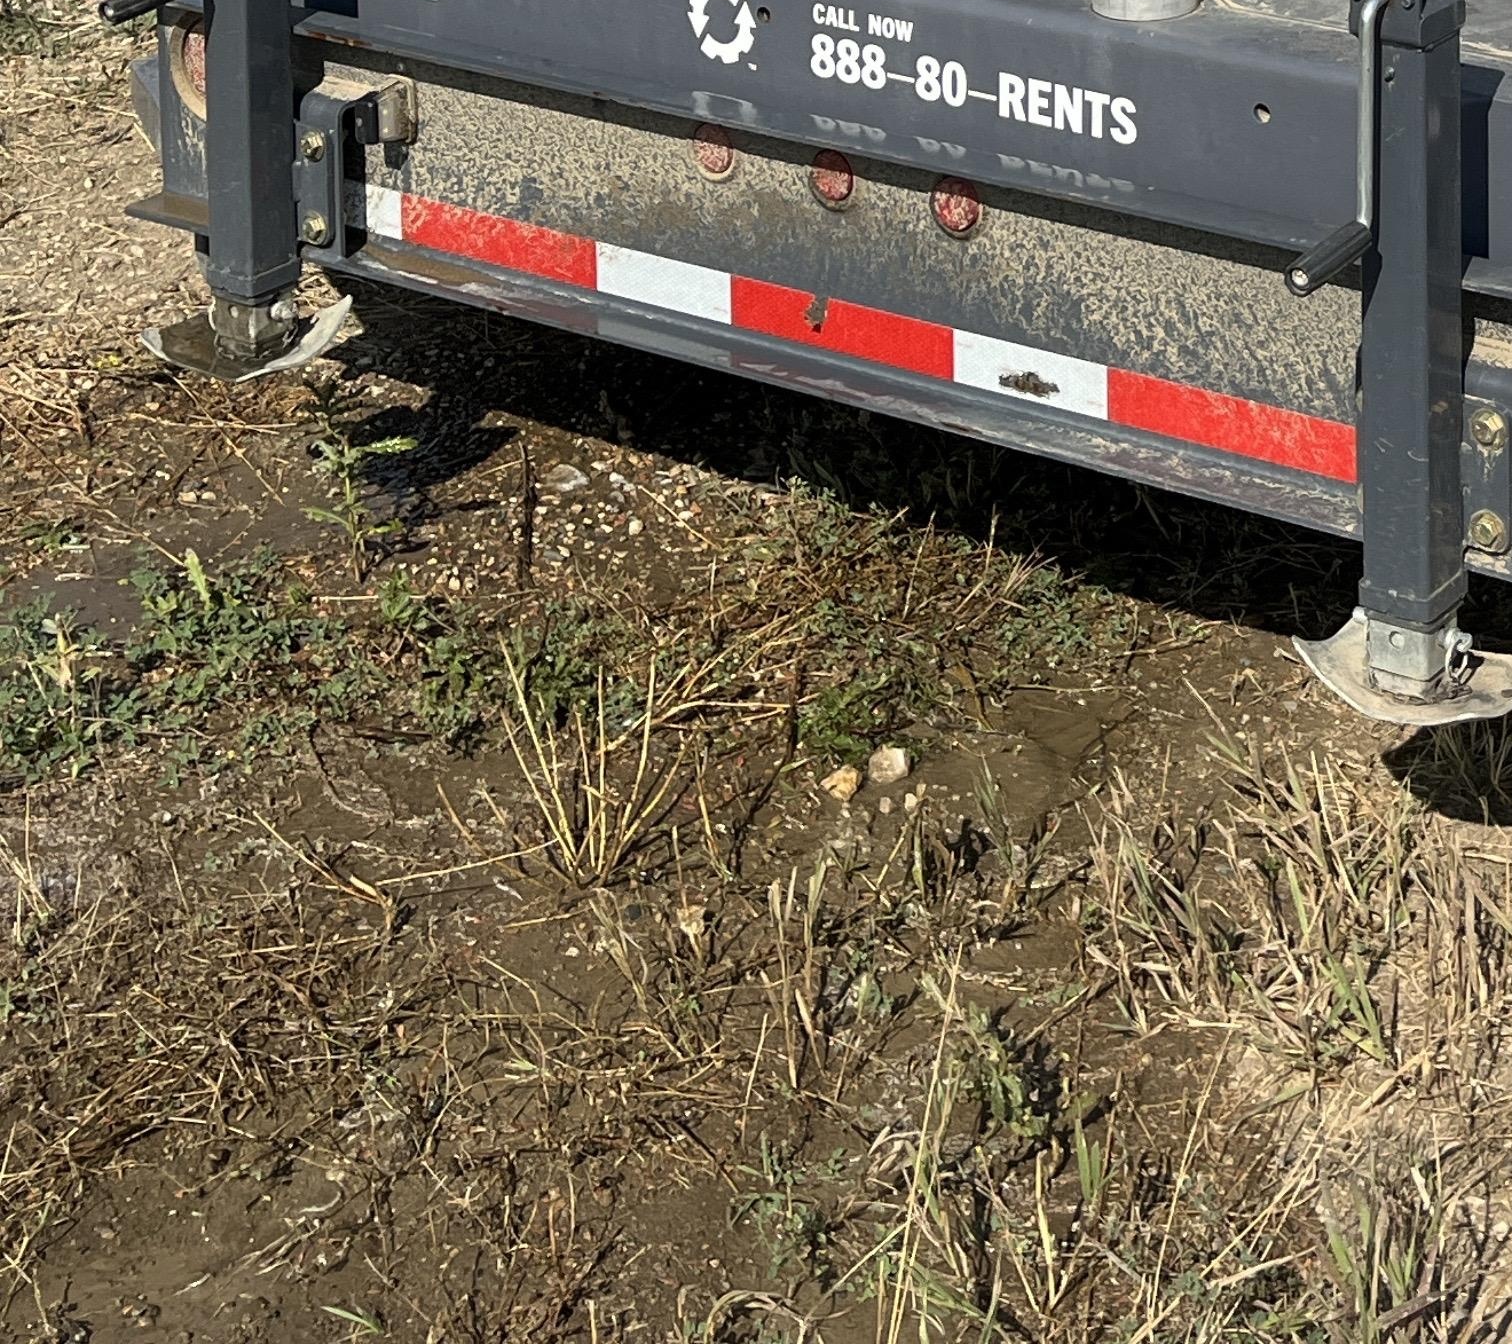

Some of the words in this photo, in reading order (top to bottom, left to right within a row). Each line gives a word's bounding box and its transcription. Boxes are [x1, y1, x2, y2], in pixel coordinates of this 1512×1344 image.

[812, 3, 860, 32] CALL
[867, 13, 914, 43] NOW
[810, 33, 1138, 145] 888-80-RENTS
